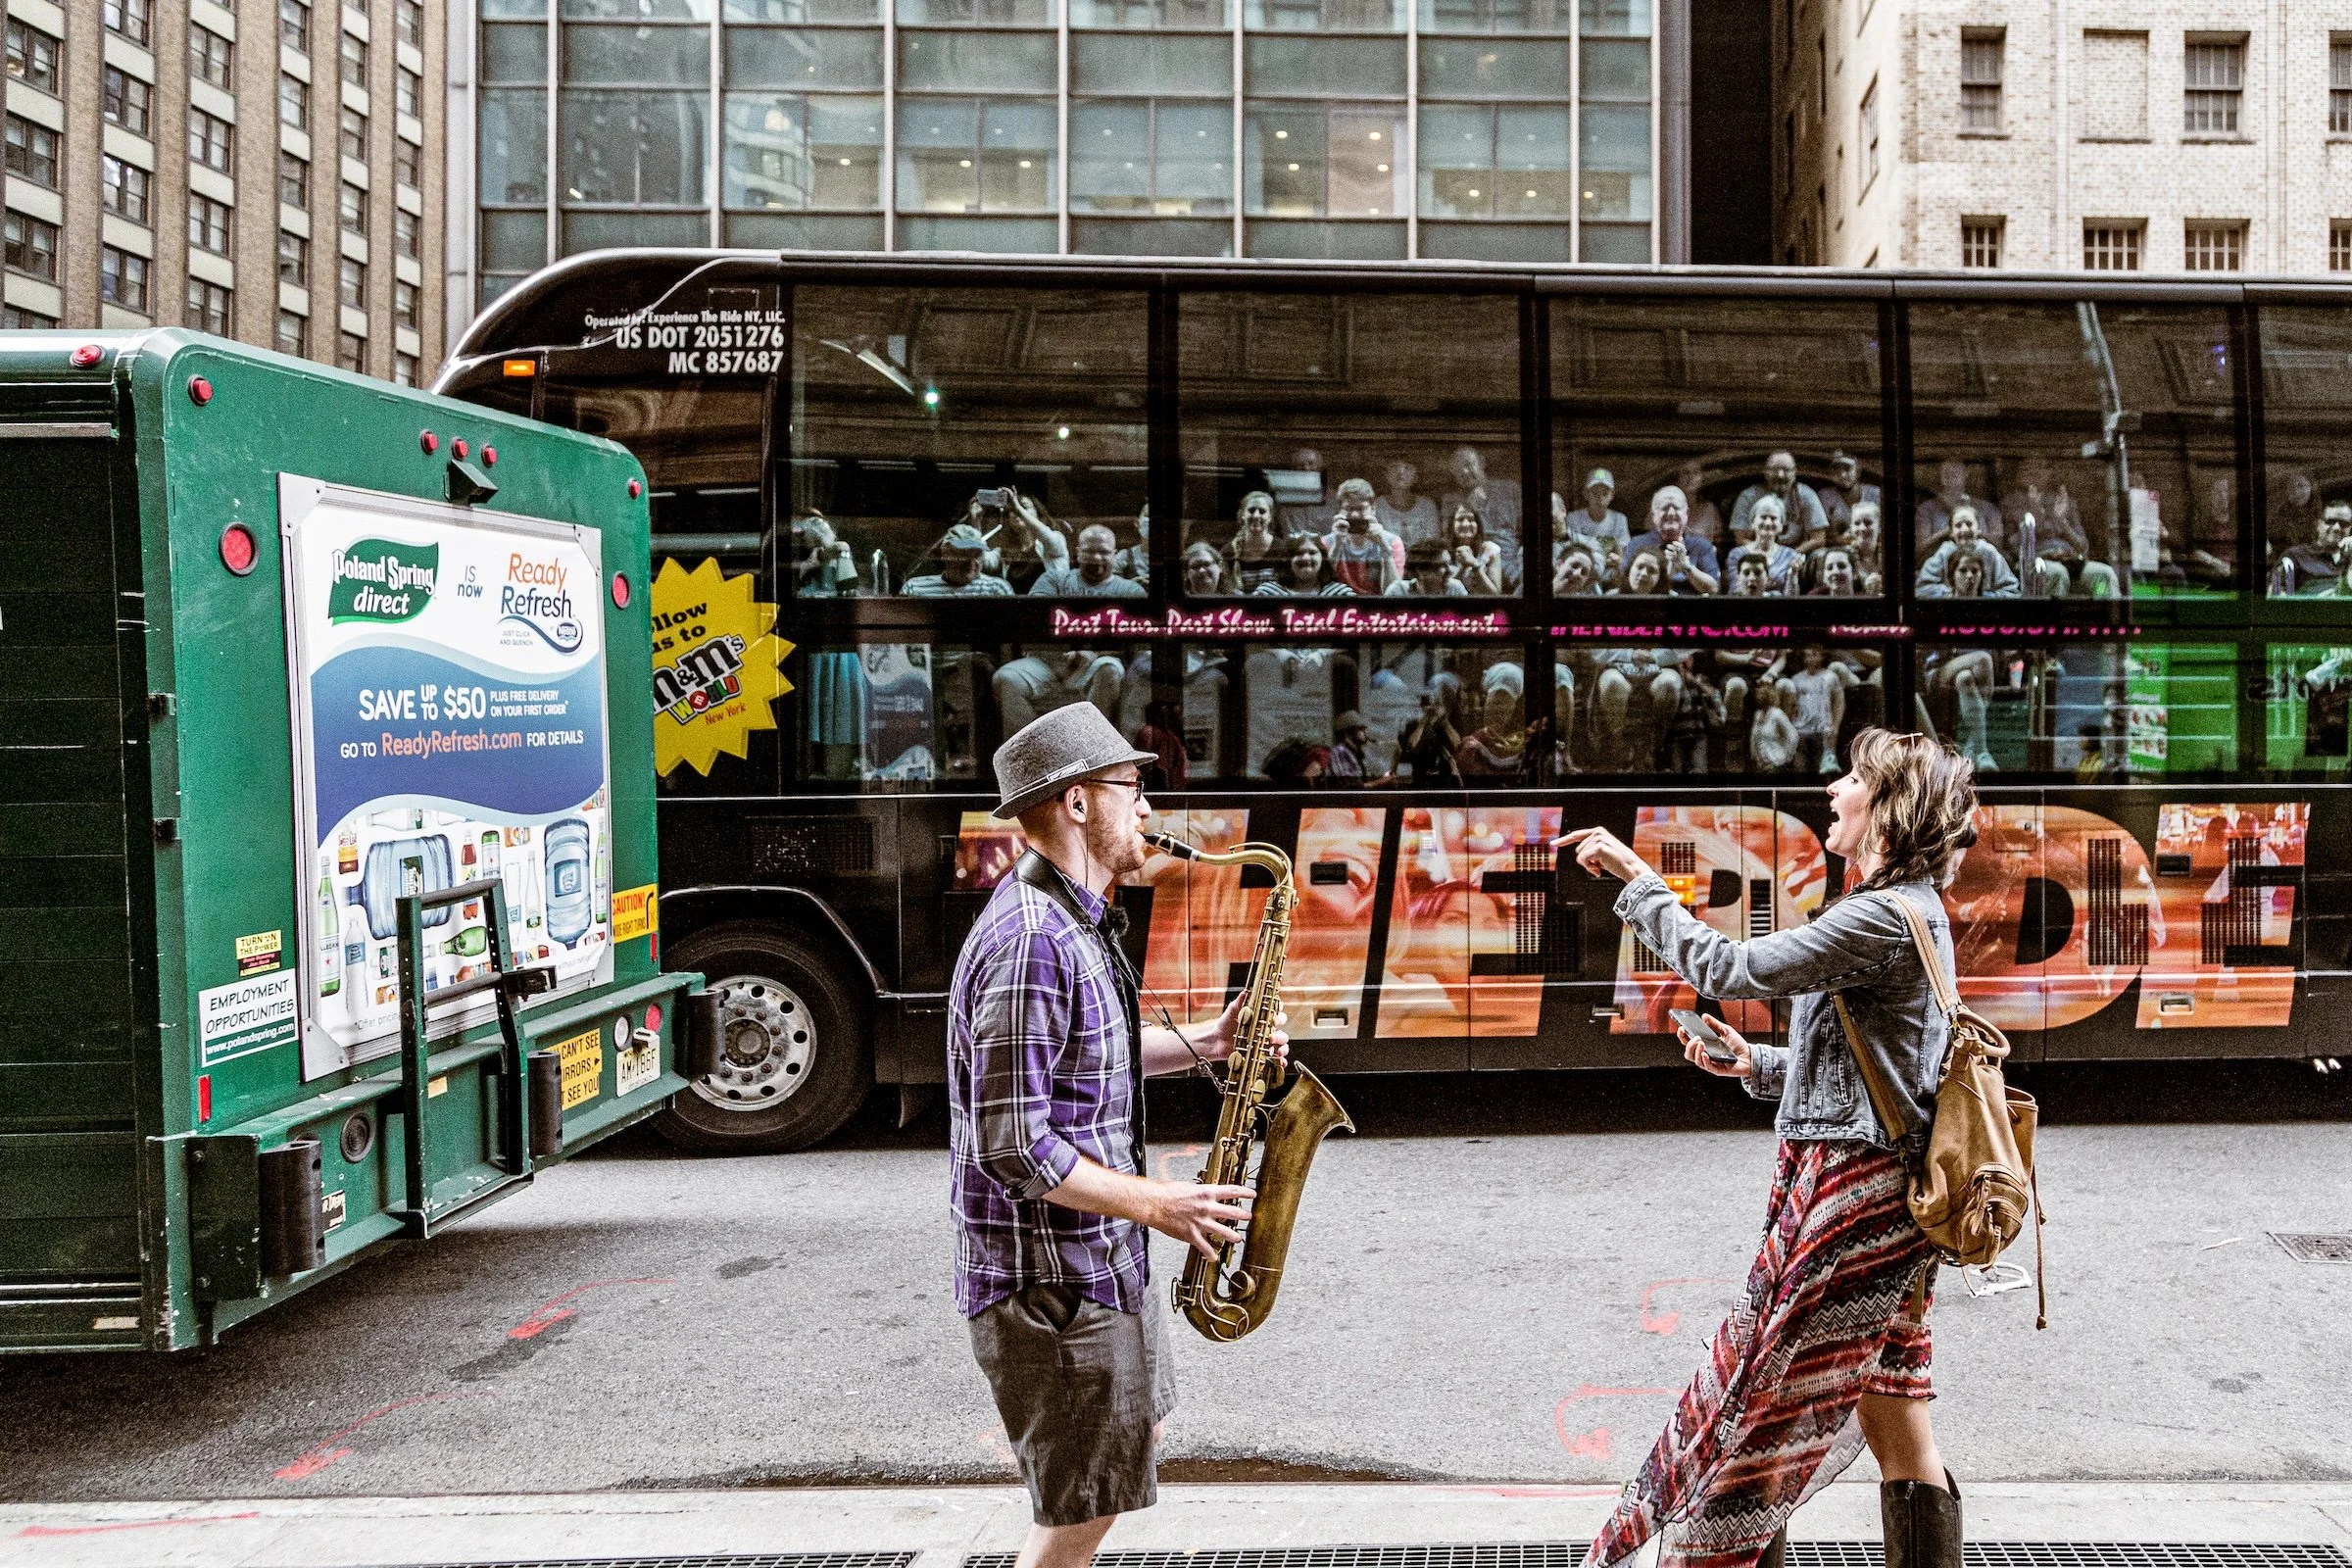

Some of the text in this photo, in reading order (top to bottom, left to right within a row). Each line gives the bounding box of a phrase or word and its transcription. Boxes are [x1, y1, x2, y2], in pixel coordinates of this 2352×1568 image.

[648, 311, 699, 326] Experience
[701, 310, 718, 322] The
[720, 310, 743, 322] Ride
[745, 310, 763, 324] NY,
[765, 310, 786, 323] LLC.
[616, 325, 785, 349] US DOT 2051276
[668, 351, 785, 373] MC 857687
[332, 549, 436, 596] Poland Spring
[465, 565, 477, 583] IS
[509, 553, 567, 594] Ready
[353, 585, 411, 614] direct
[458, 584, 483, 598] now
[501, 586, 572, 618] Refresh
[652, 603, 707, 633] llow
[1277, 609, 1338, 634] Total
[679, 625, 706, 642] to
[359, 688, 416, 720] SAVE
[420, 684, 438, 702] UP
[443, 684, 487, 720] $50
[490, 689, 560, 703] PLUS FREE DELIVERY
[420, 702, 439, 720] TO
[490, 706, 503, 717] ON
[503, 705, 523, 717] YOUR
[523, 704, 543, 716] FIRST
[706, 702, 746, 725] New York
[340, 728, 584, 760] GO TO ReadyRefresh.com FOR DETAILS
[241, 935, 263, 948] TURN
[210, 979, 290, 1011] EMPLOYMENT
[206, 999, 294, 1034] OPPORTUNITIES
[206, 1022, 295, 1055] www.polandspring.com
[562, 1032, 599, 1059] CAN'T SEE
[562, 1057, 595, 1083] IRRORS,
[567, 1084, 581, 1102] SEE
[582, 1076, 599, 1096] YOU
